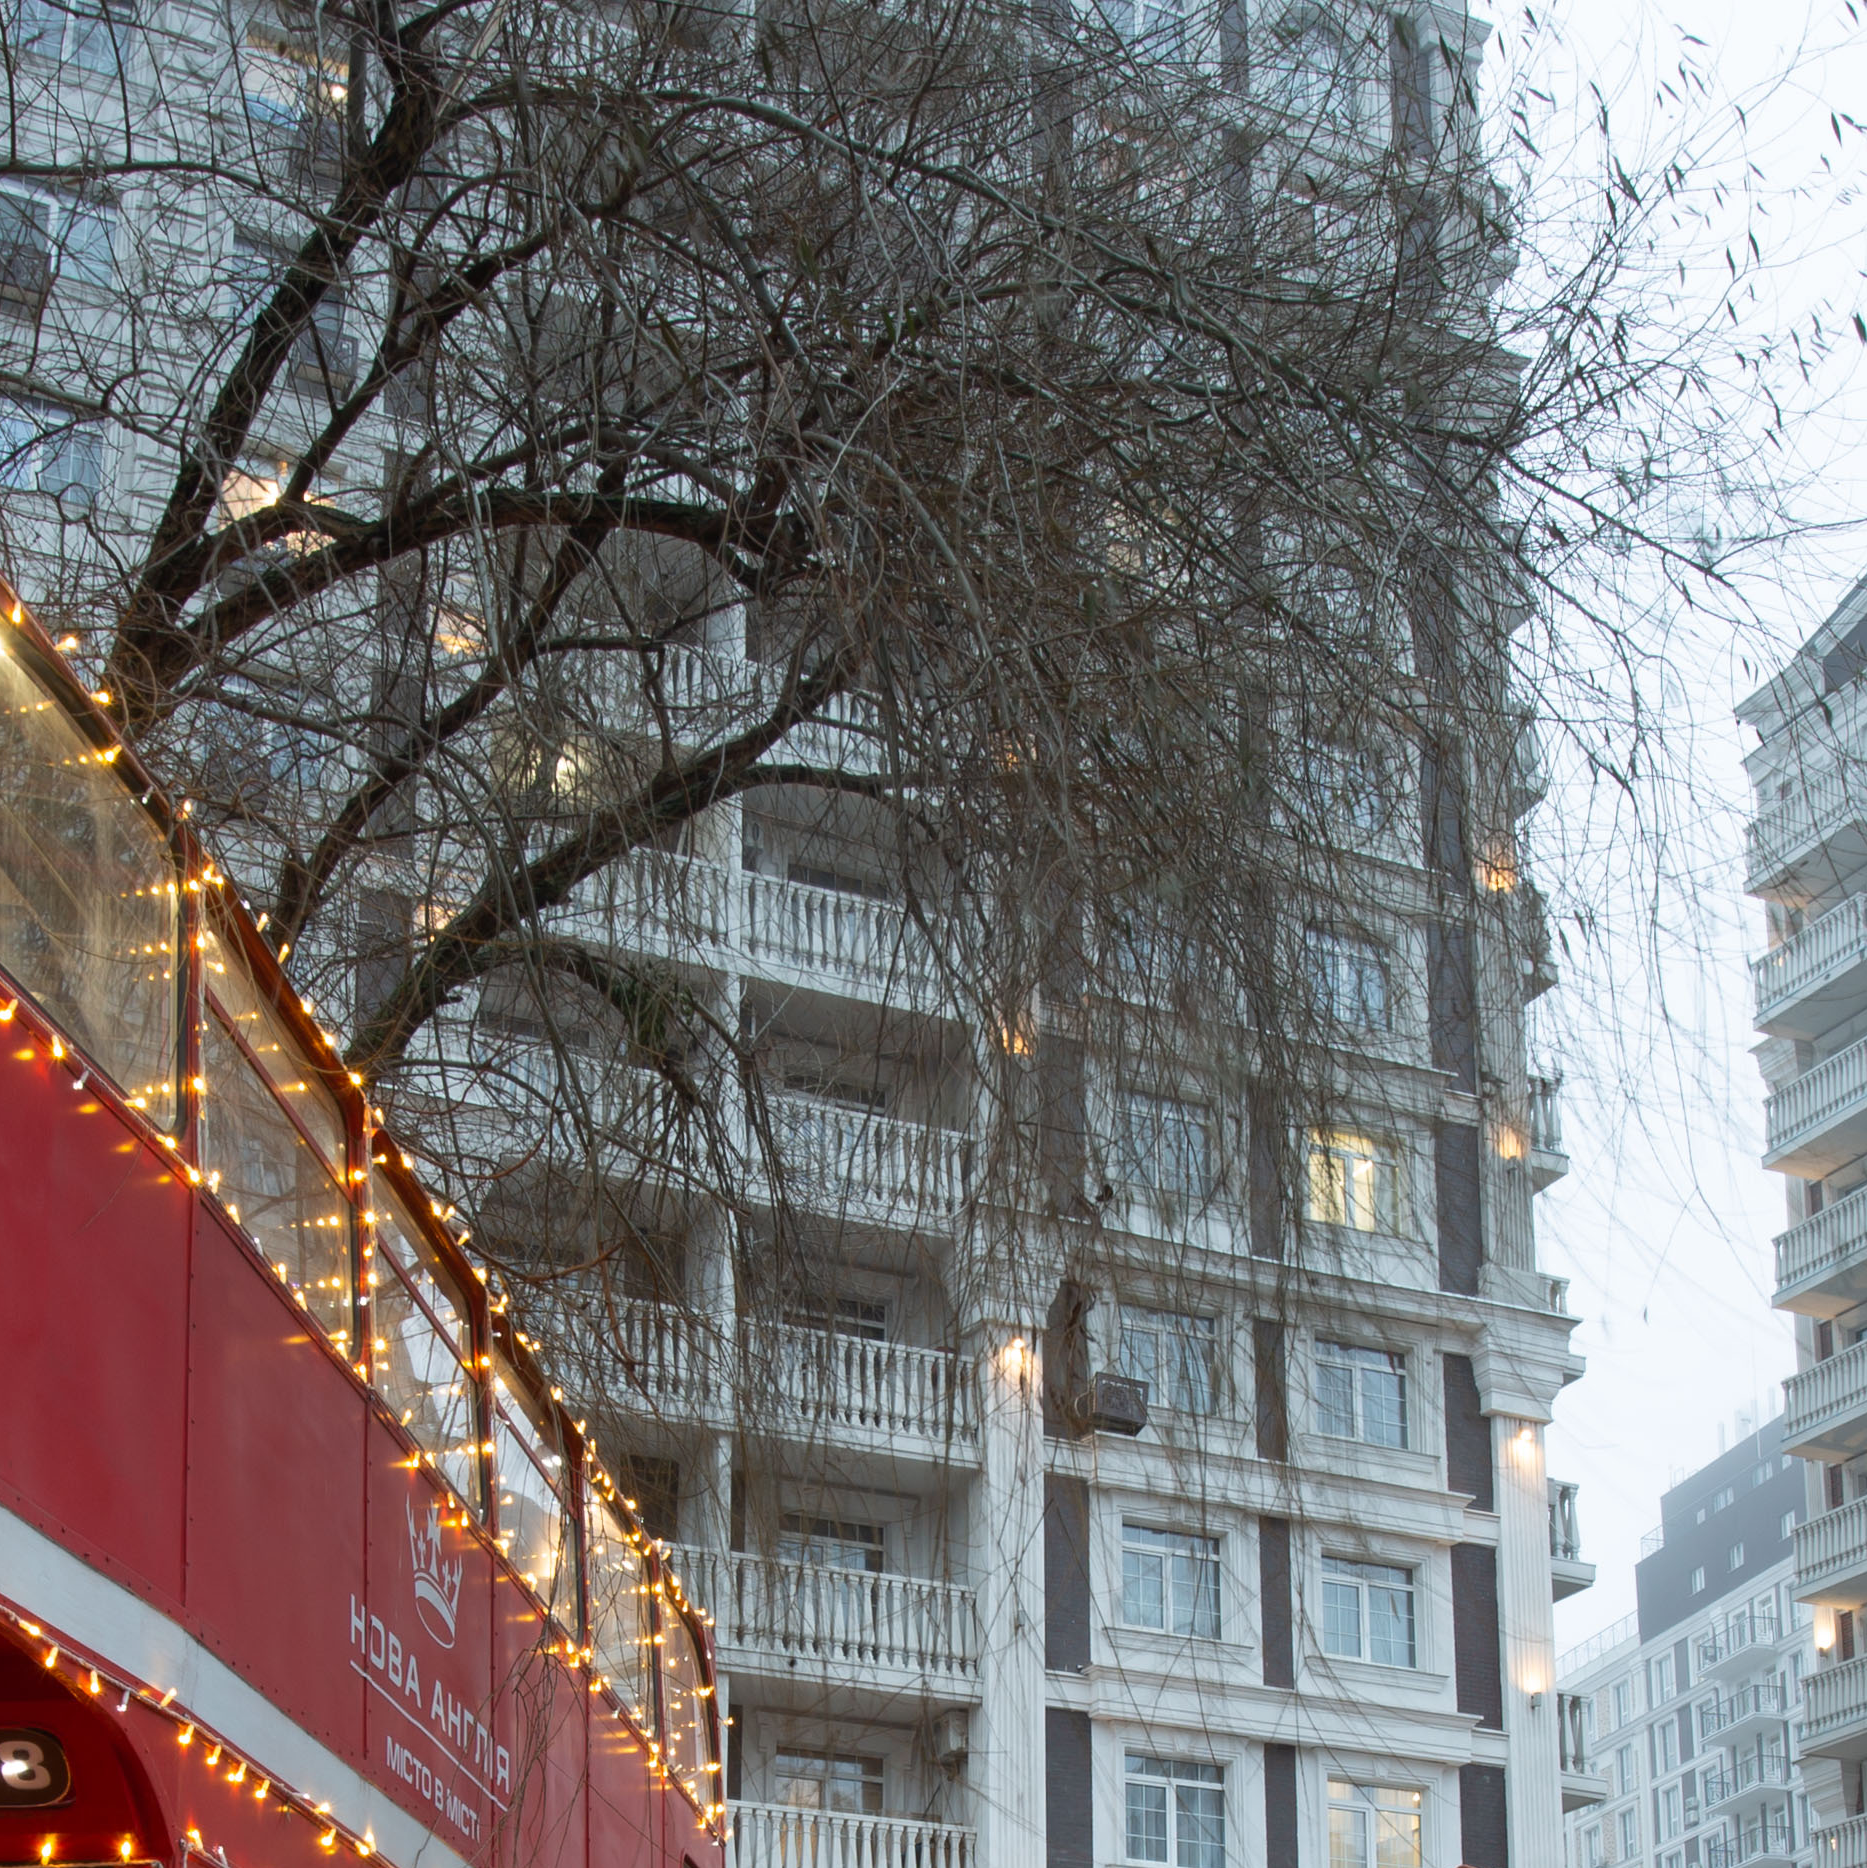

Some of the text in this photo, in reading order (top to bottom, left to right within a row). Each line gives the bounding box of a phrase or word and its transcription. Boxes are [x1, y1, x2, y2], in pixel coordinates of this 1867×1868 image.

[350, 1592, 510, 1795] НОВА АНГЛІЯ
[385, 1735, 432, 1801] МІСТО
